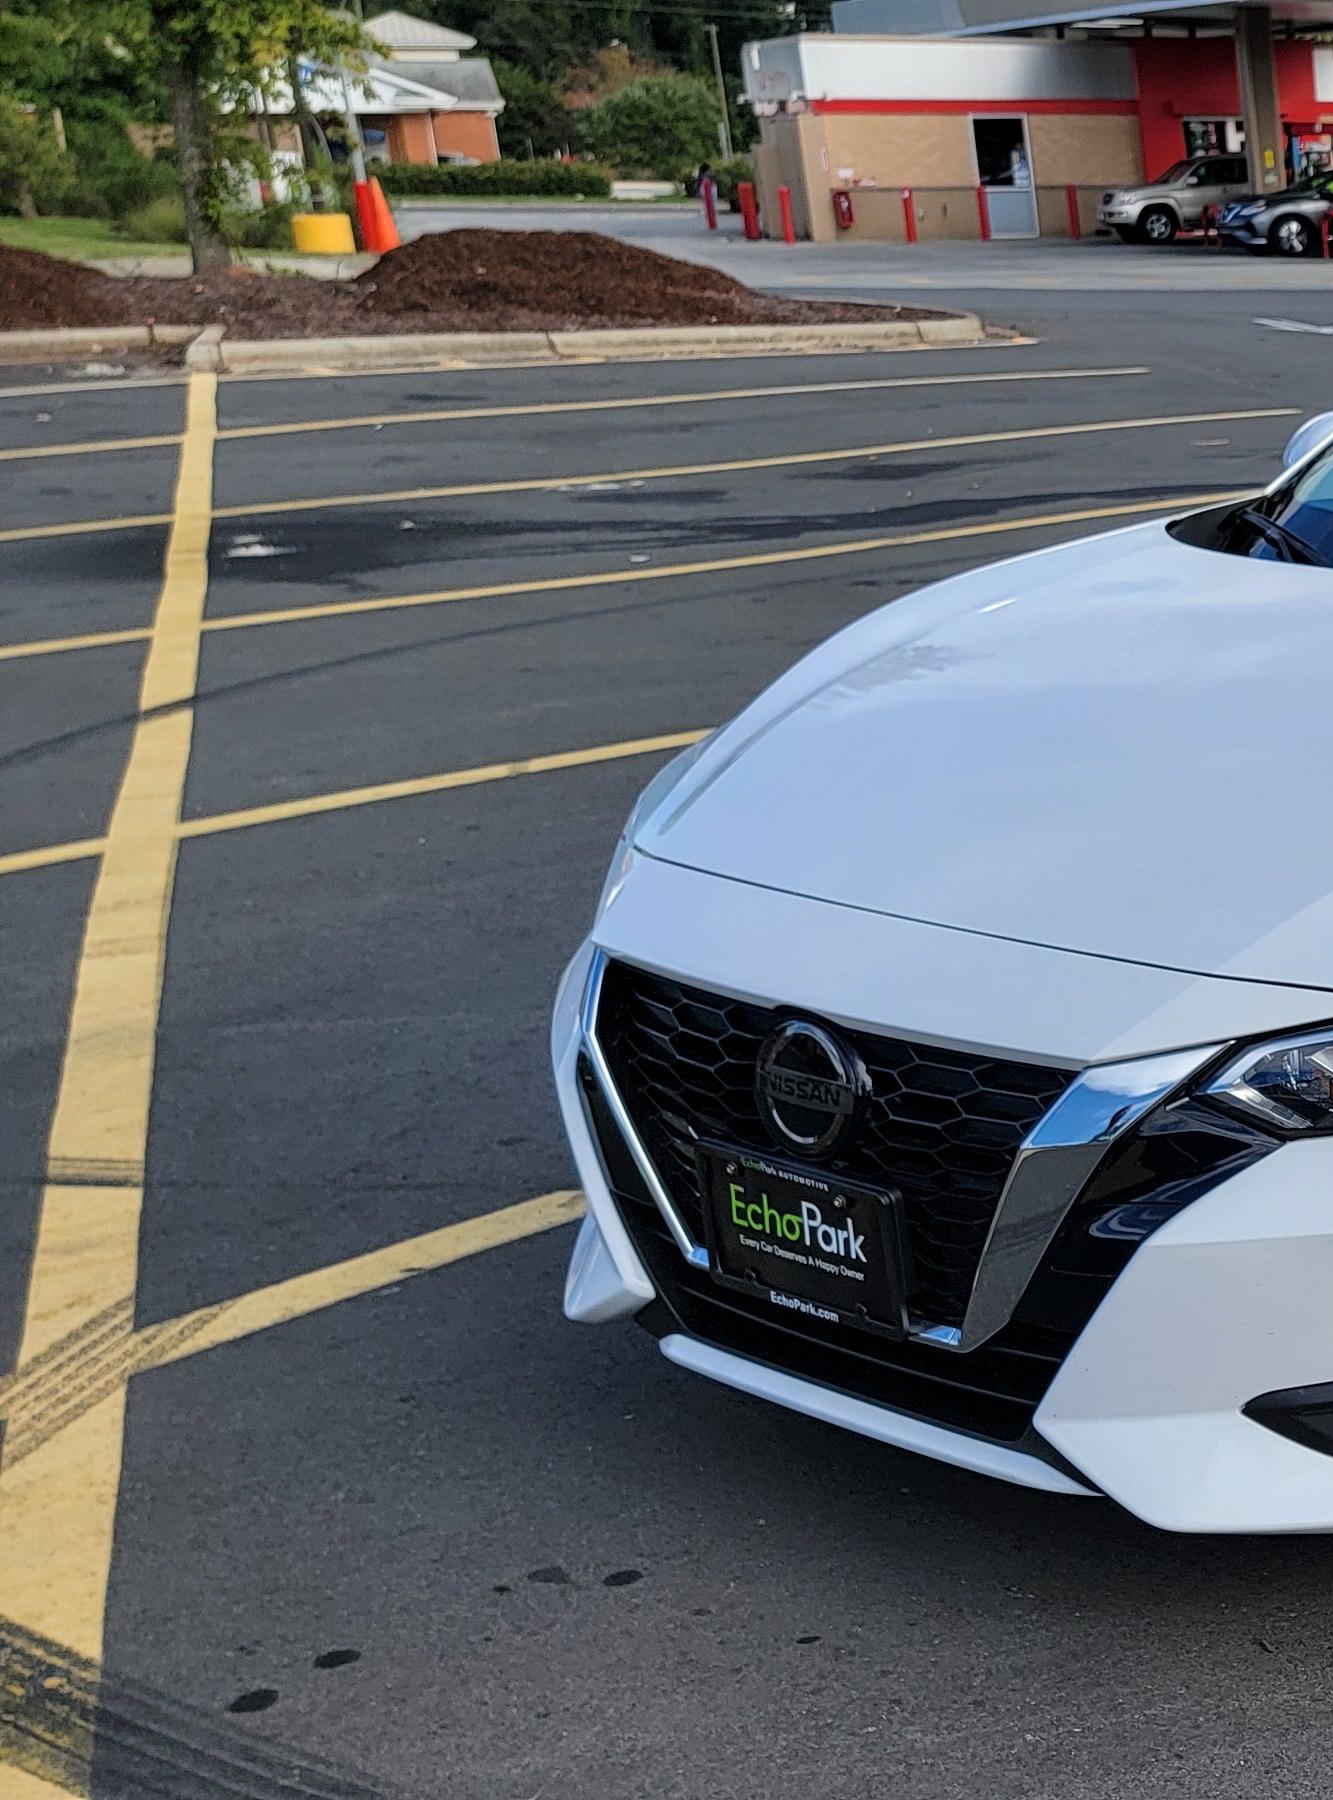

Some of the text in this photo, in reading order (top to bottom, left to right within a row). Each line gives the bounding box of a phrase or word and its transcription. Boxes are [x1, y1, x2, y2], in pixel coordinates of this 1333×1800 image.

[768, 1072, 841, 1107] NISSAN
[778, 1169, 829, 1192] AUTOMOTIVE
[729, 1182, 867, 1263] EchoPark
[739, 1233, 865, 1281] Every Car Deserves A Happy Owner
[769, 1290, 839, 1322] EchoPark.com
